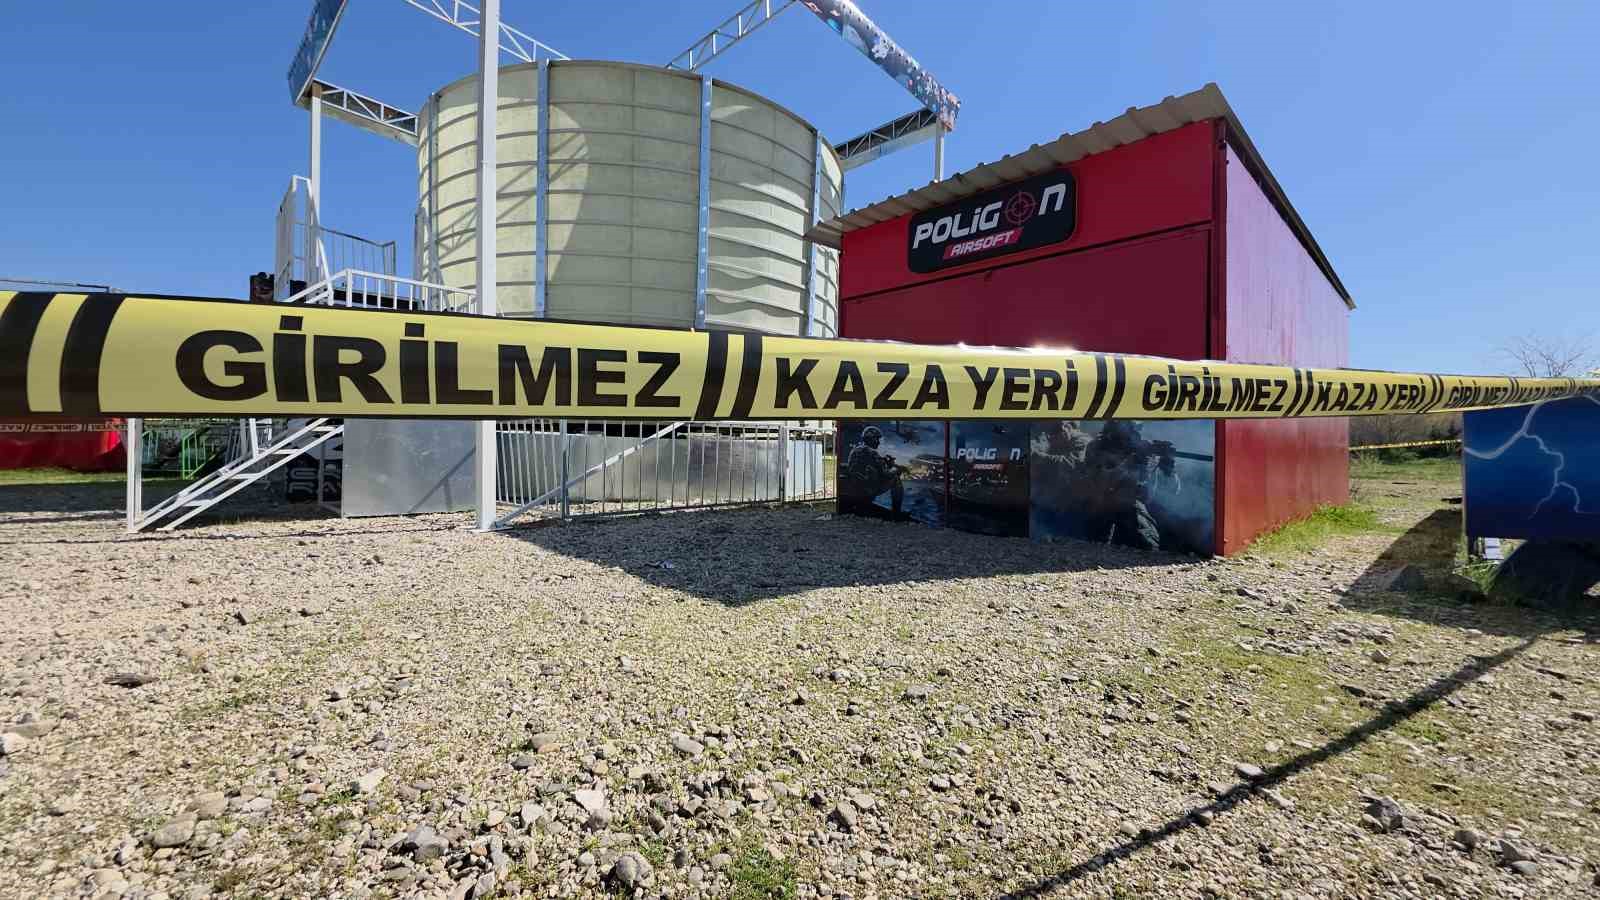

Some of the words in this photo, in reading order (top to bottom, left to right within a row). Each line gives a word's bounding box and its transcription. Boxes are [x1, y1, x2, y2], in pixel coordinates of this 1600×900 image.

[951, 231, 1015, 257] AIRSOFT
[176, 315, 680, 407] GİRİLMEZ
[774, 358, 950, 410] KAZA
[964, 359, 1078, 410] YERİ
[1142, 365, 1288, 411] GİRİLMEZ
[1312, 381, 1378, 411] KAZA
[1380, 377, 1426, 410] YERİ
